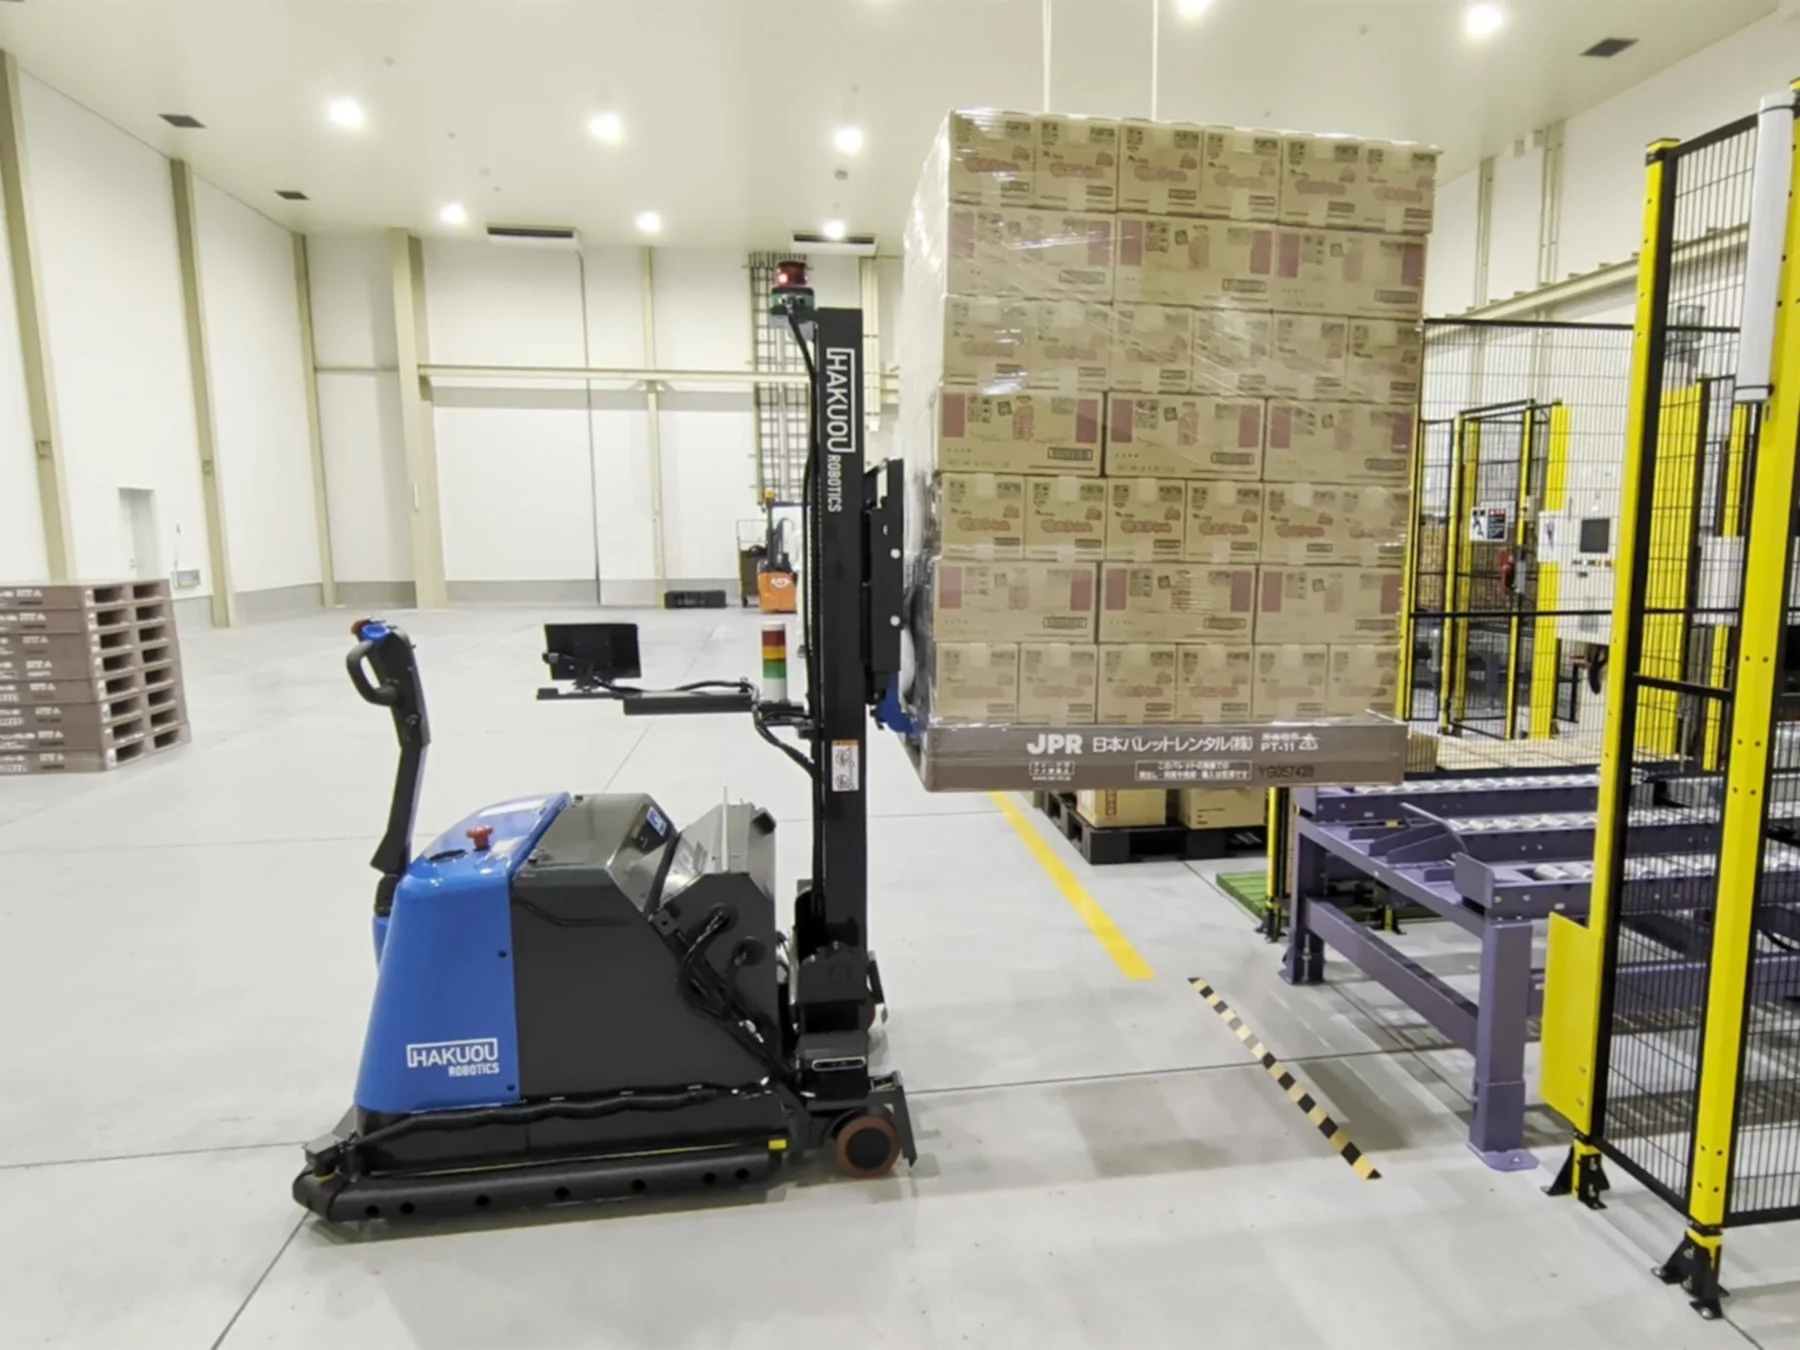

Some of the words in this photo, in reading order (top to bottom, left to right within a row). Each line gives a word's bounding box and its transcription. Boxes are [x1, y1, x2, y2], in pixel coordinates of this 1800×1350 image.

[826, 347, 855, 453] HAKUOU
[827, 455, 842, 512] ROBOTICS
[1026, 733, 1084, 755] JPR
[406, 1038, 499, 1068] HAKUOU
[448, 1062, 500, 1077] ROBOTICS
